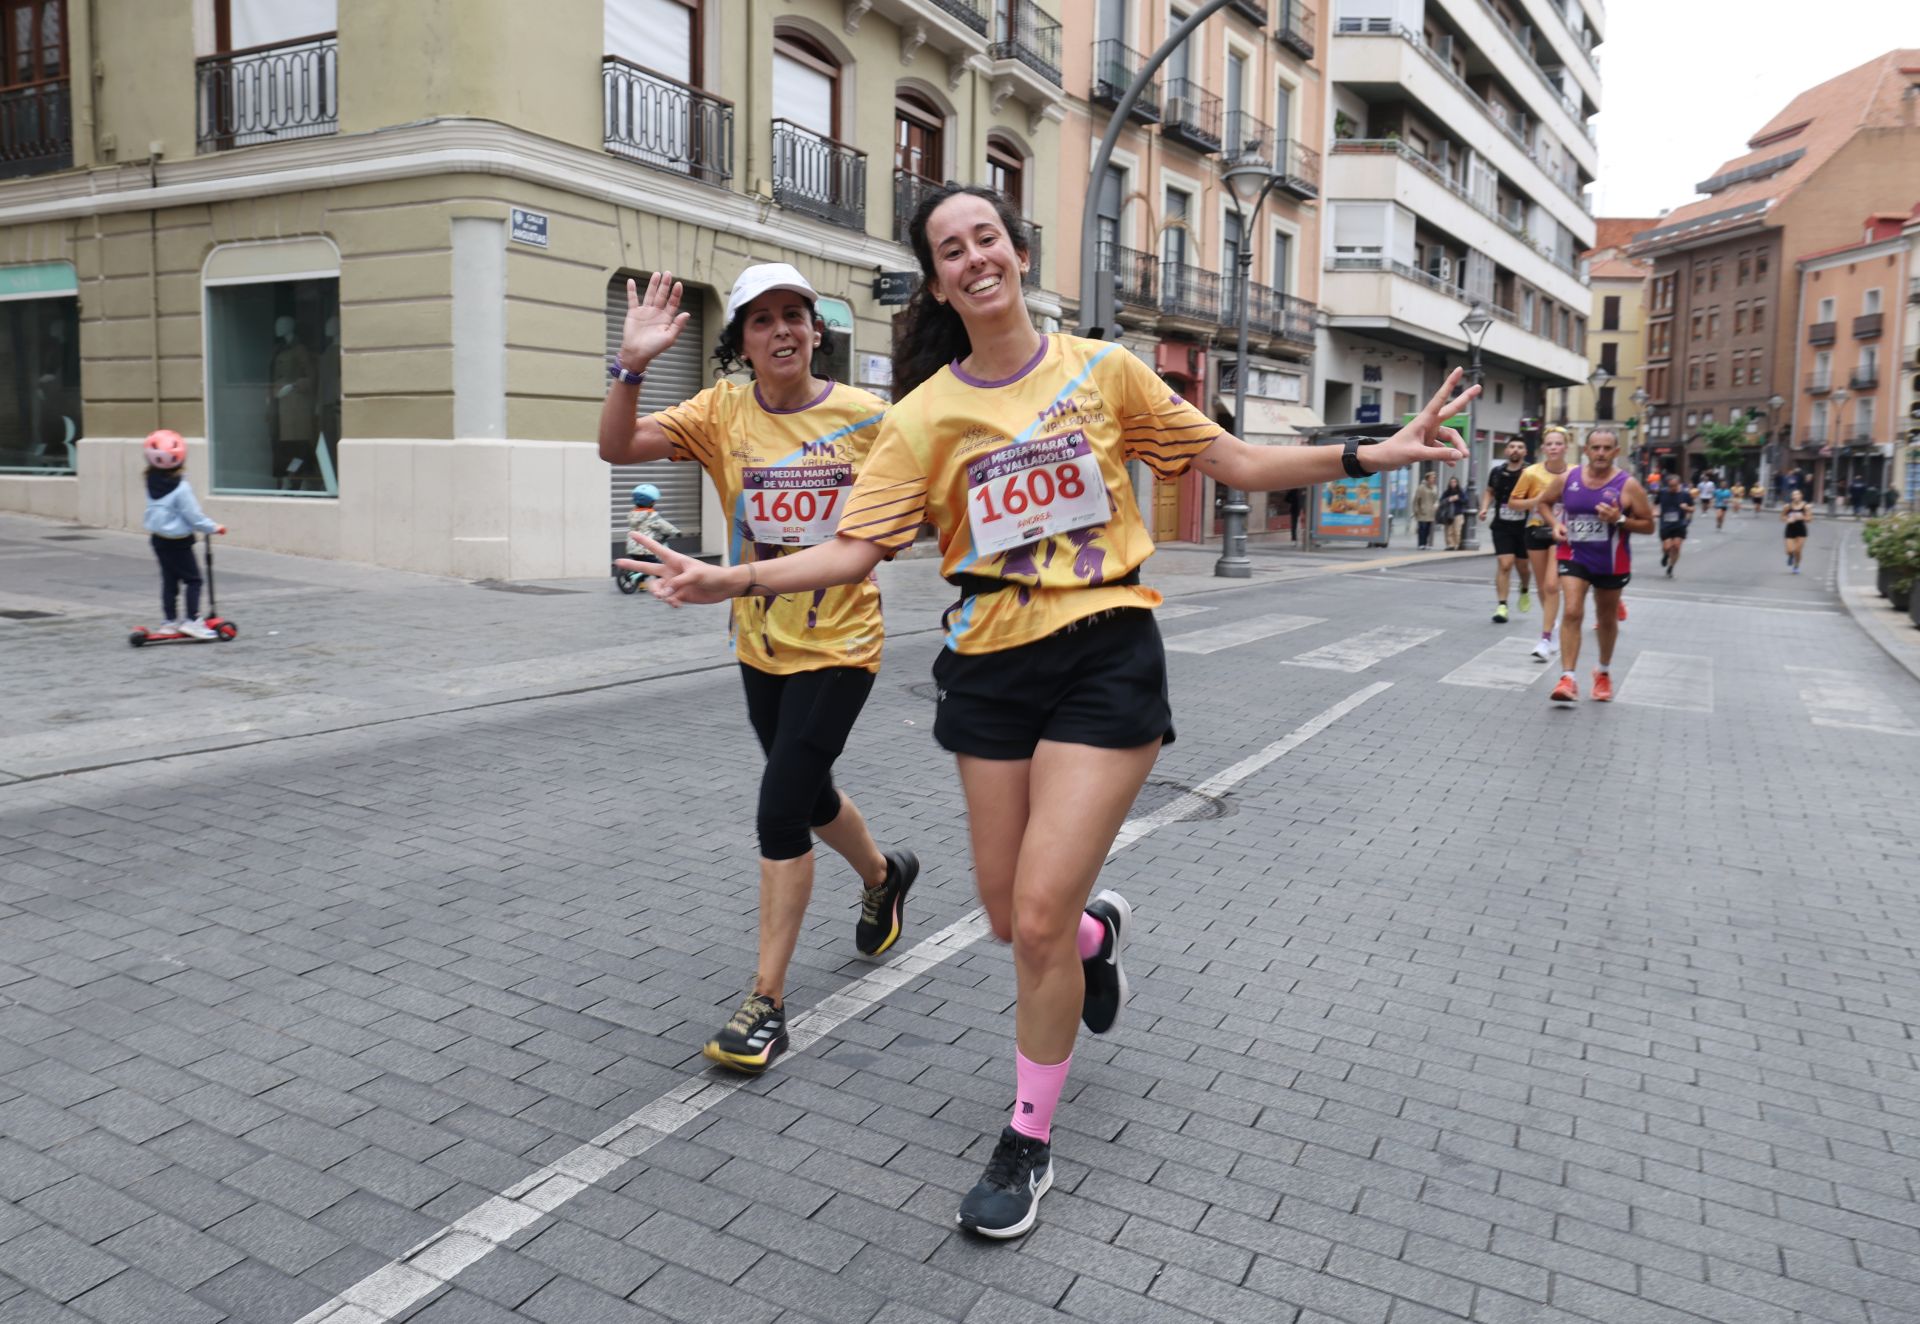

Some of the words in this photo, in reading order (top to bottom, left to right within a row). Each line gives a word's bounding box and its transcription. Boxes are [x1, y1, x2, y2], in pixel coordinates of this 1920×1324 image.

[991, 446, 1031, 463] MEDIA
[986, 464, 1002, 479] DE
[1002, 448, 1075, 474] VALLADOLID
[769, 470, 802, 479] MEDIA
[778, 478, 838, 488] VALLADOLID
[976, 463, 1085, 524] 1608
[751, 489, 839, 522] 1607
[1569, 520, 1604, 534] 1232
